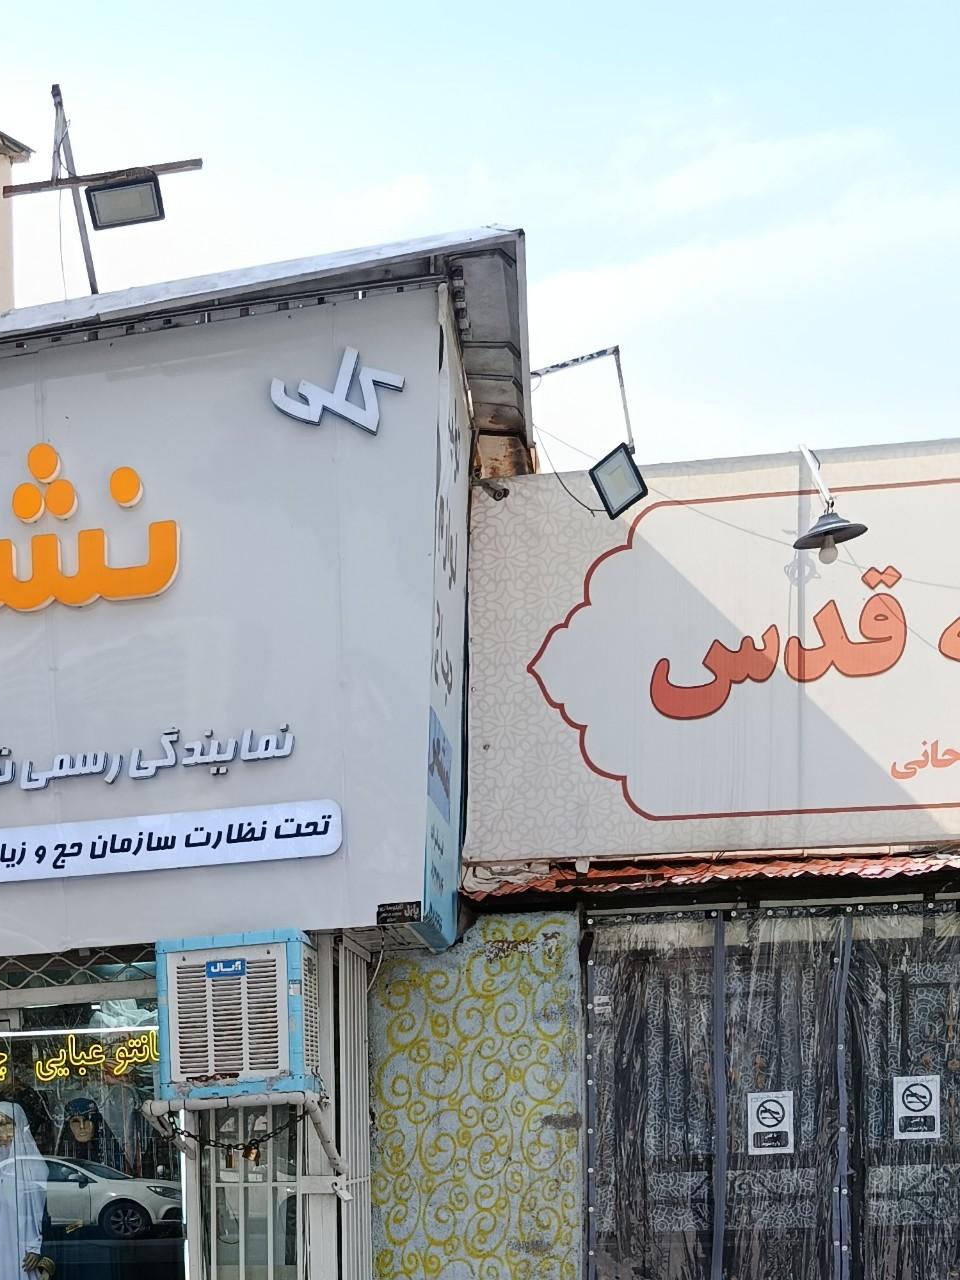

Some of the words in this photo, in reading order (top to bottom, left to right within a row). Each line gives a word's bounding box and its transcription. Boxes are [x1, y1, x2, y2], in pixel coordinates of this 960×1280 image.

[270, 346, 405, 435] کلی
[649, 565, 908, 721] قدس
[19, 750, 124, 791] رسمی
[128, 723, 296, 780] نمایندگی
[889, 738, 960, 780] حانی
[89, 831, 177, 860] سازمان
[183, 820, 268, 848] نظارت
[273, 814, 333, 839] تحت
[34, 847, 46, 864] و
[51, 842, 83, 870] حج
[35, 1034, 106, 1082] عبایی
[114, 1030, 161, 1076] انتو
